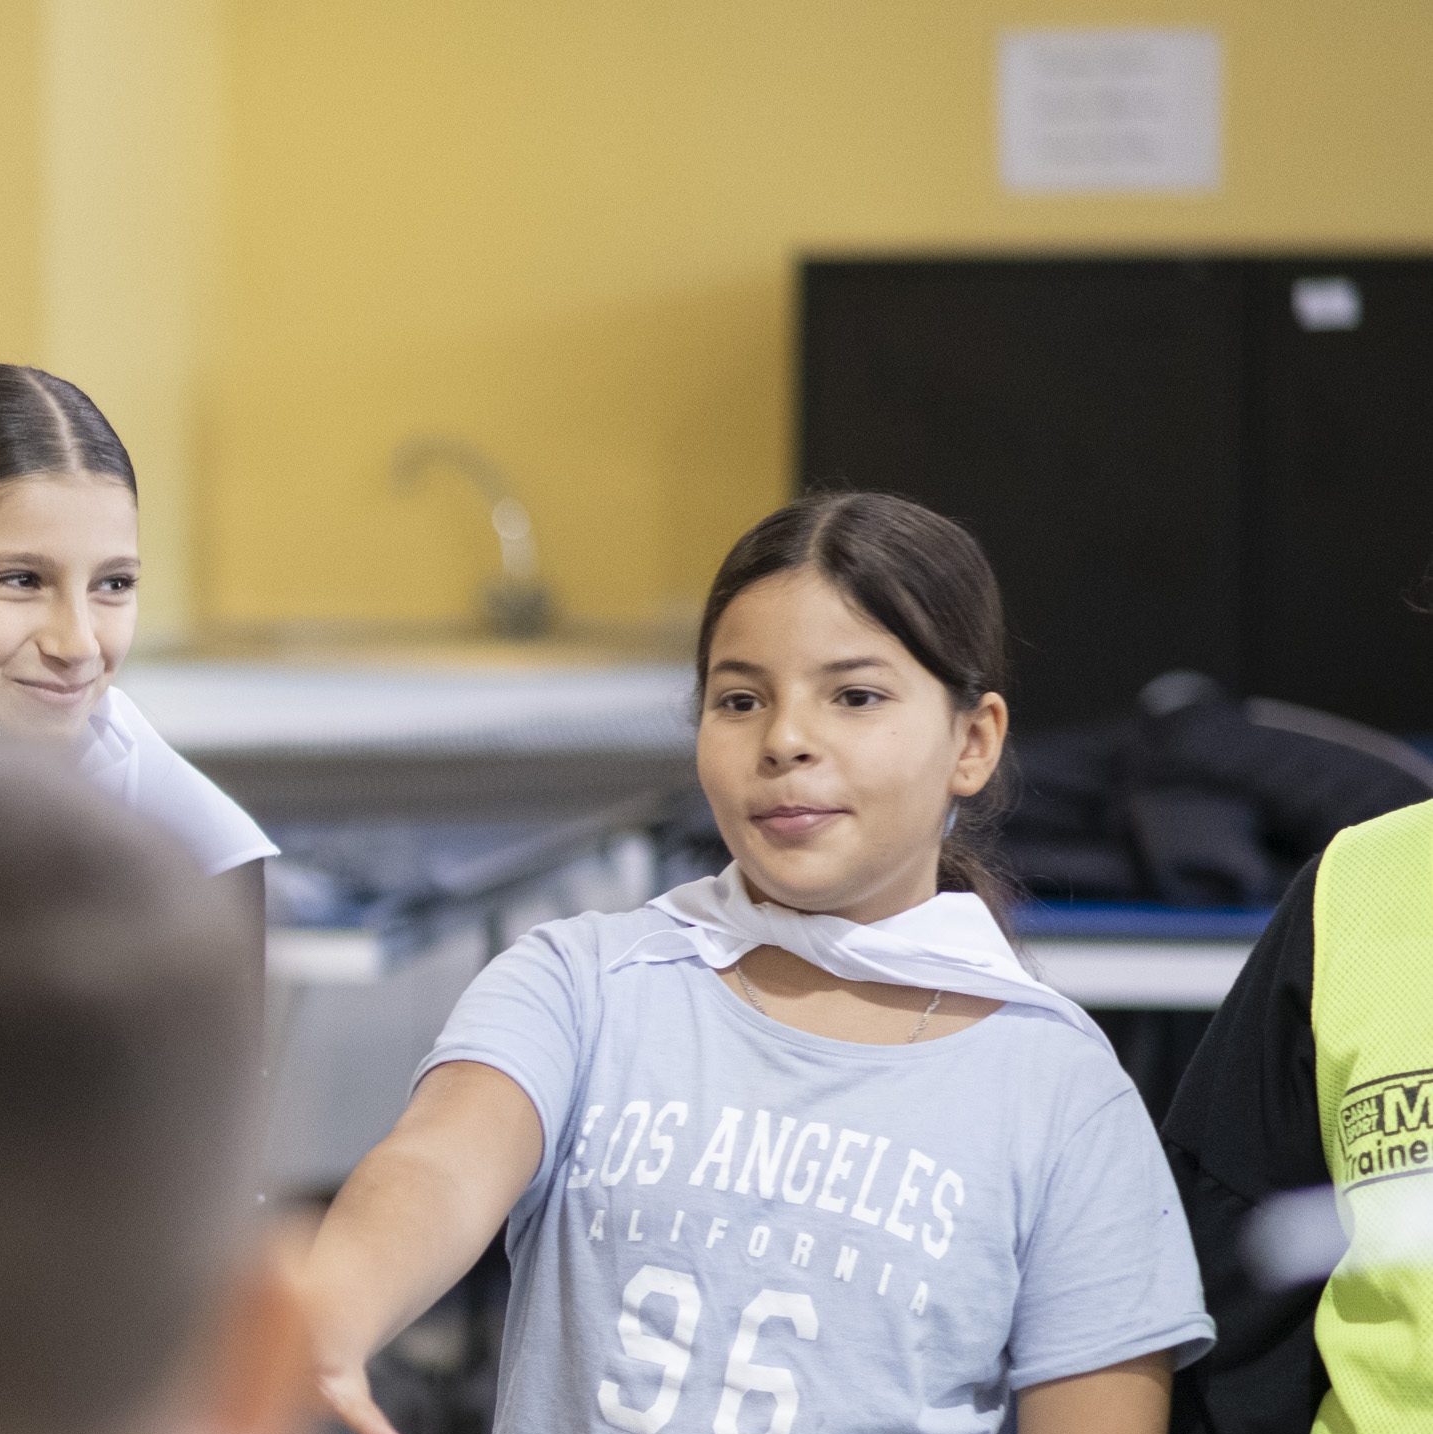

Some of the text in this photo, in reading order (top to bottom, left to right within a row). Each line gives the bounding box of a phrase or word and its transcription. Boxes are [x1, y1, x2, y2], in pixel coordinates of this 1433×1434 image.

[566, 1100, 966, 1260] LOS ANGELES
[586, 1208, 930, 1317] ALIFORNIA
